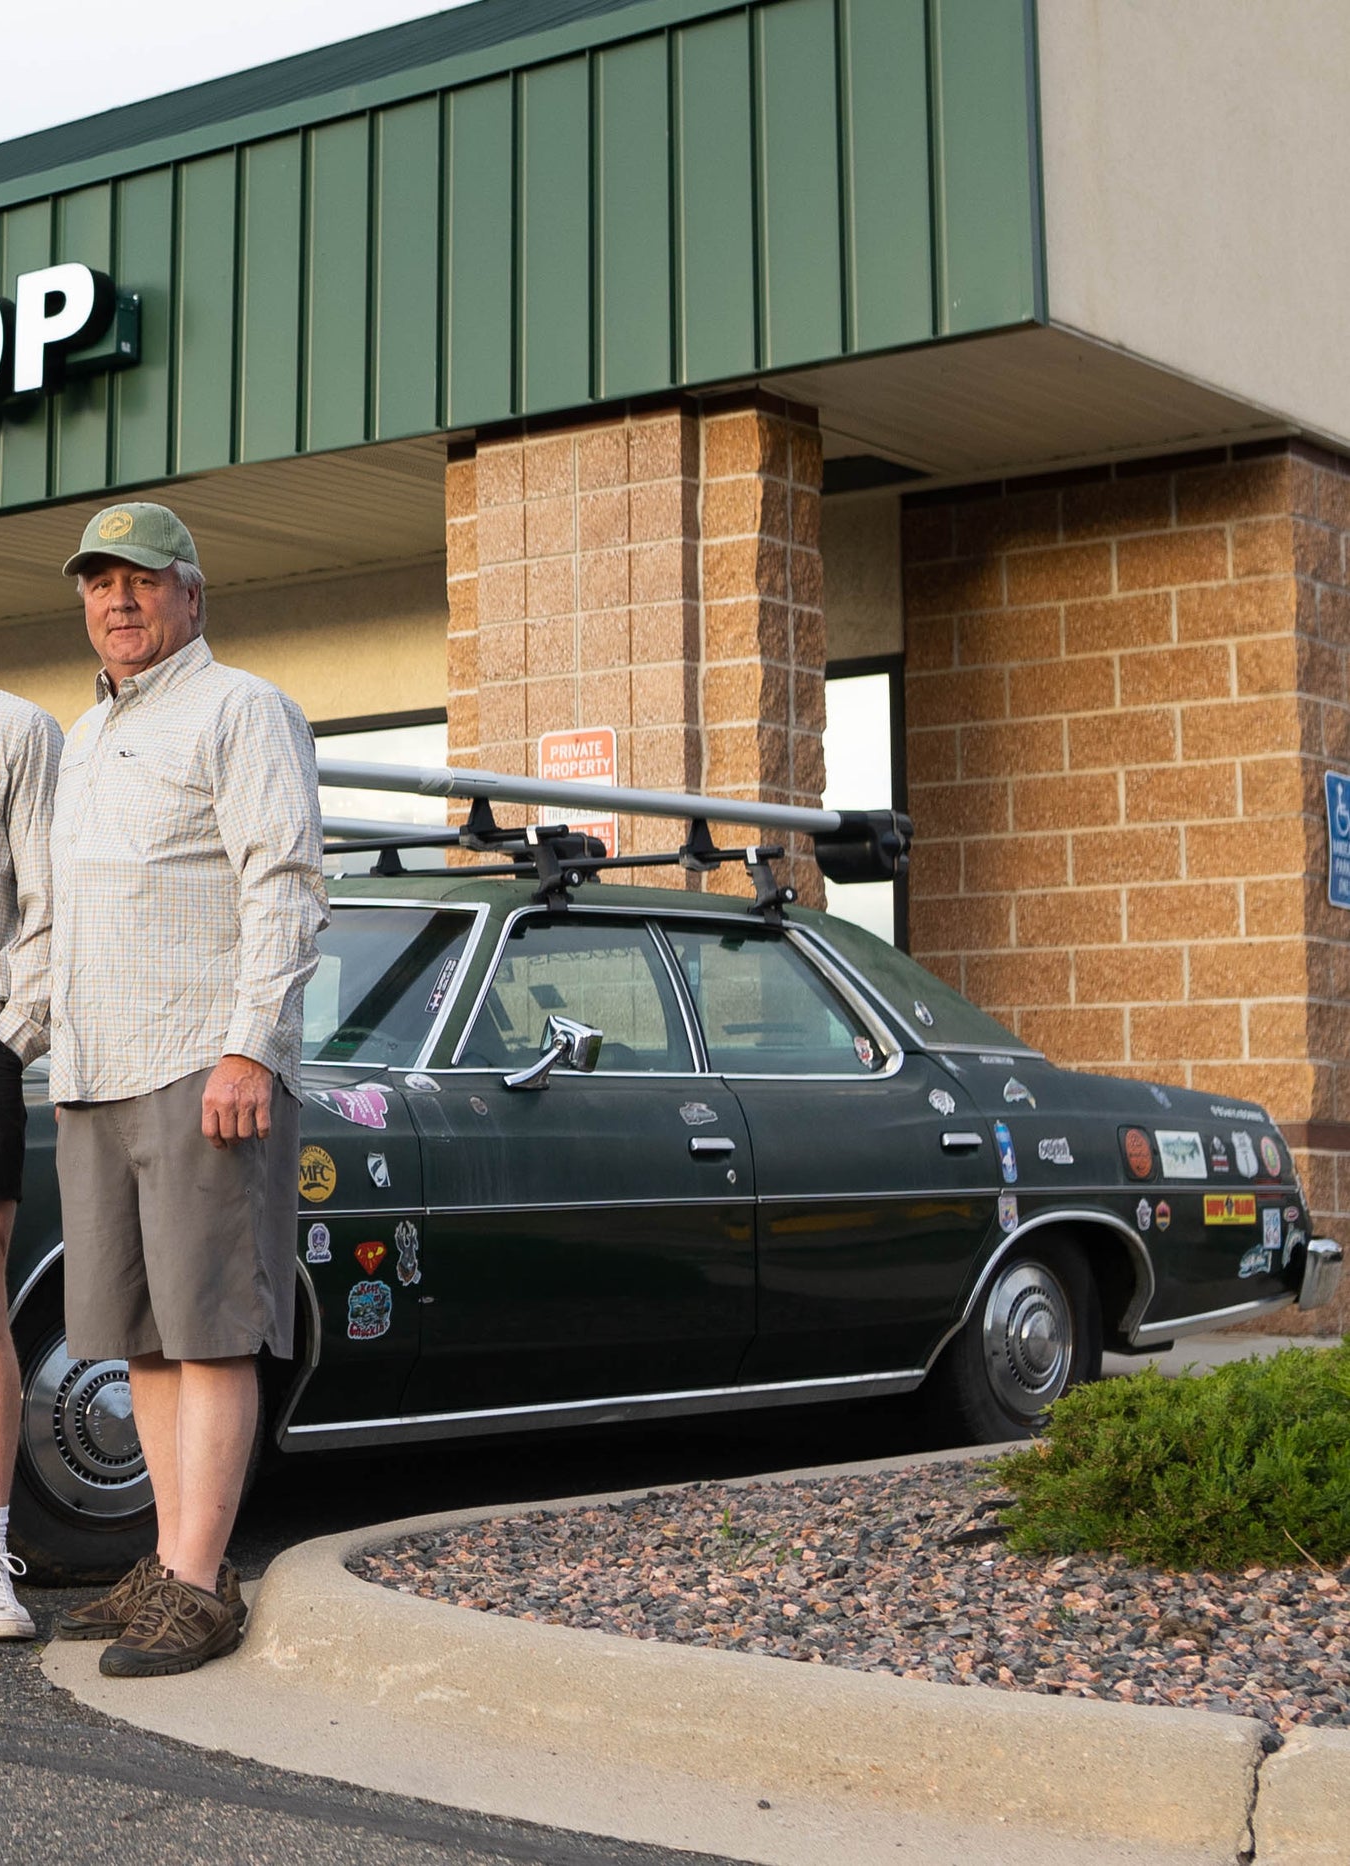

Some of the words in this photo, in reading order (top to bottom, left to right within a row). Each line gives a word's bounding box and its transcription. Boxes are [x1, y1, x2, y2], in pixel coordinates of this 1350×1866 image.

[550, 741, 603, 760] PRIVATE
[544, 758, 611, 778] PROPERTY
[299, 1163, 331, 1182] MFC
